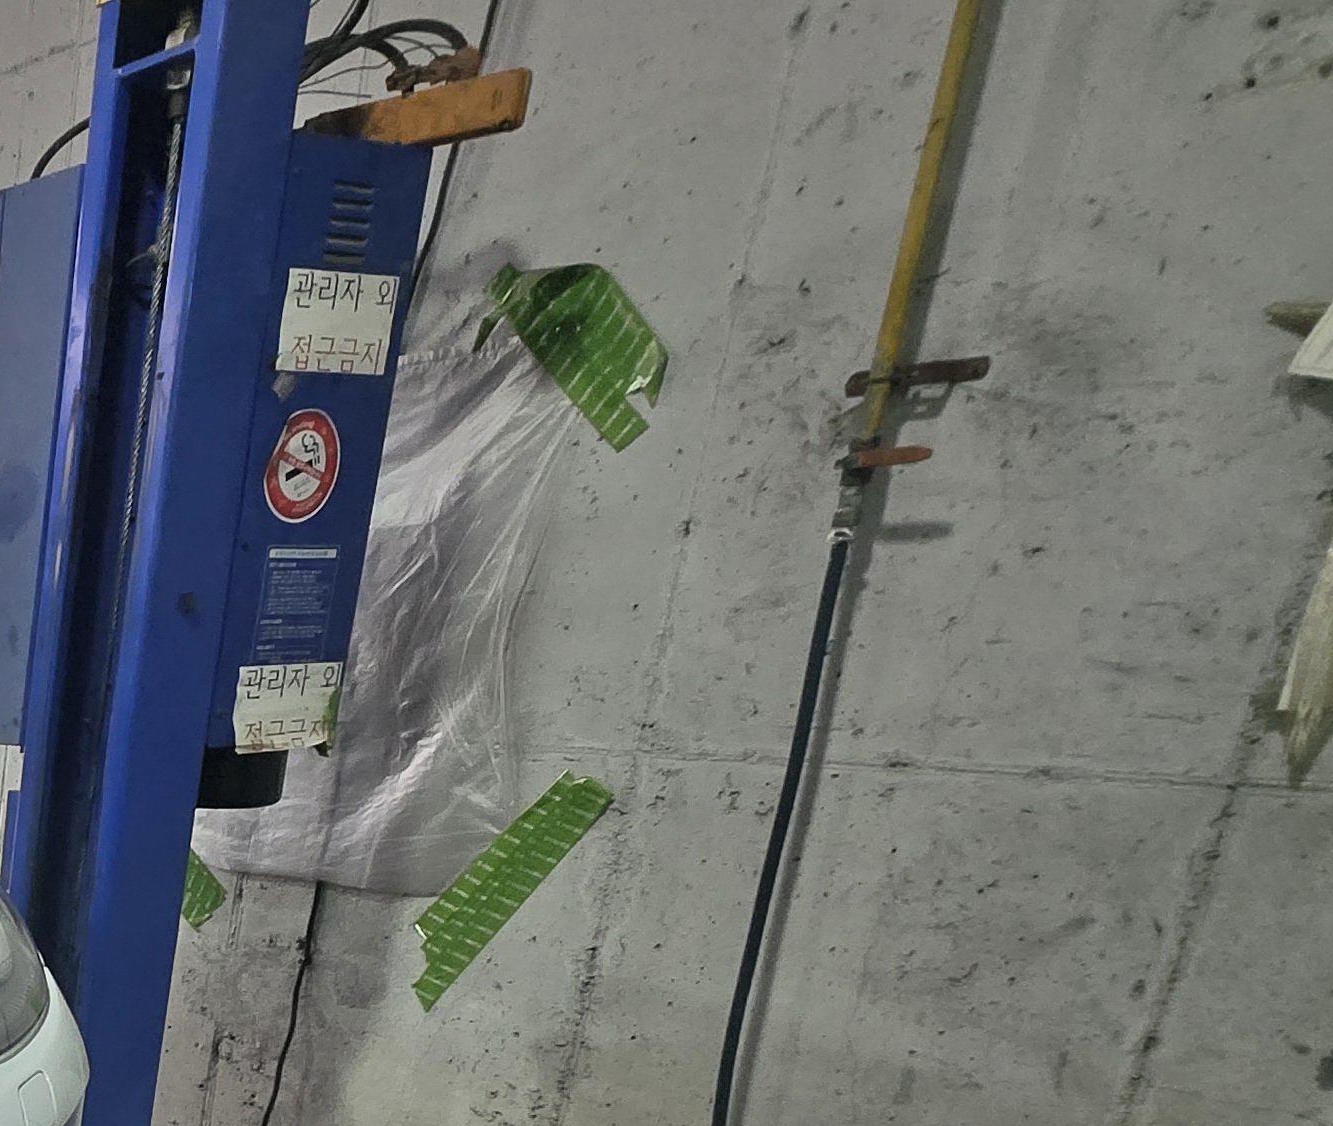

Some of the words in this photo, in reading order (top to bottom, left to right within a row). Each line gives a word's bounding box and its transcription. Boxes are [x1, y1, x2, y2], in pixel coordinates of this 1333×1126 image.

[293, 271, 364, 313] 관리자
[374, 278, 397, 314] 외
[291, 334, 382, 374] 접근금지
[244, 664, 310, 699] 관리자
[320, 663, 341, 688] 외
